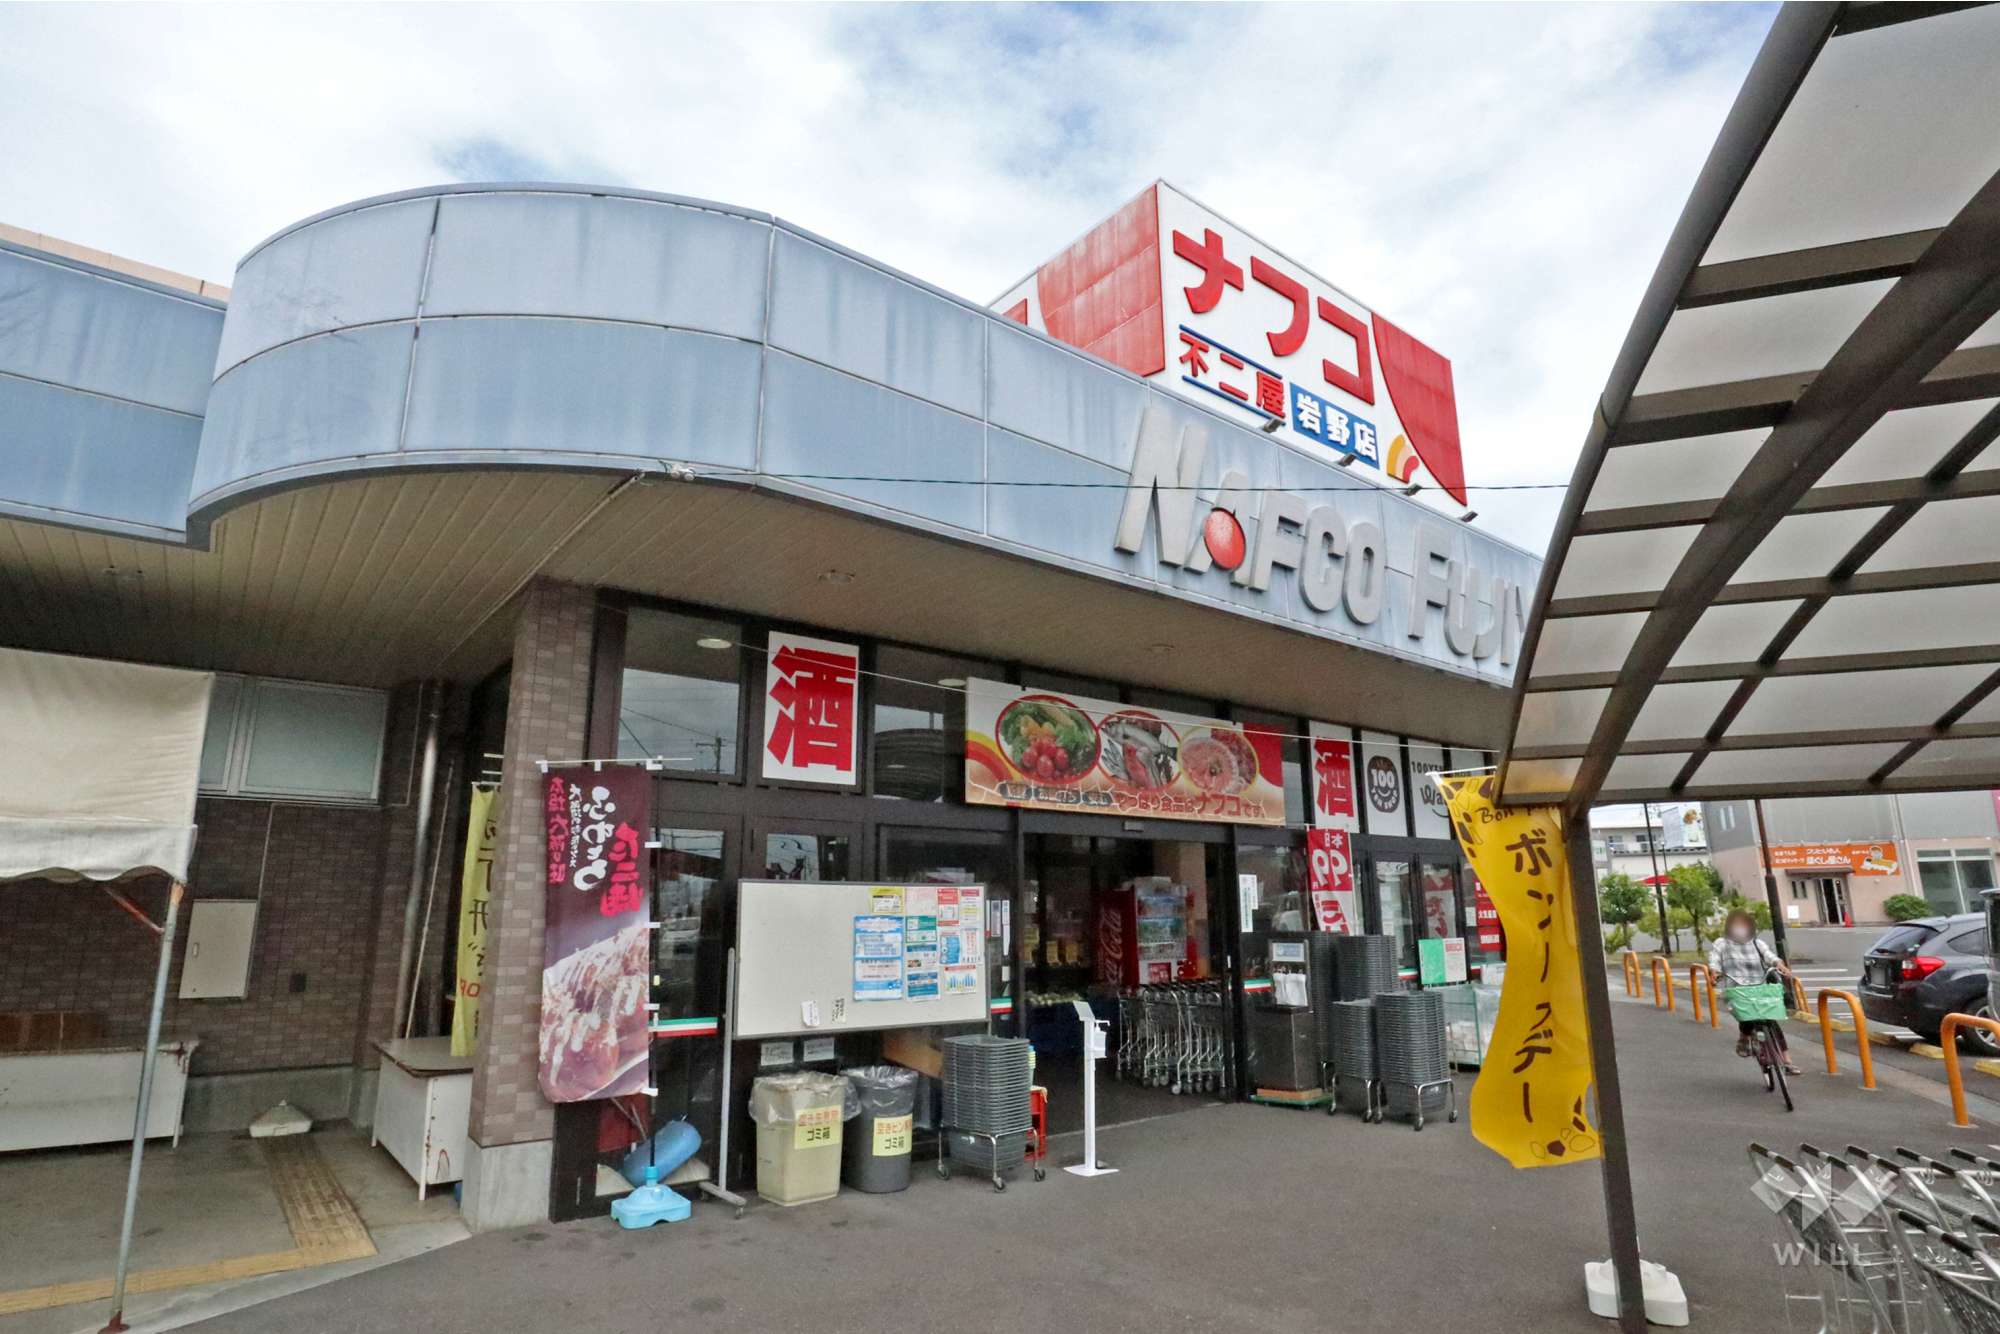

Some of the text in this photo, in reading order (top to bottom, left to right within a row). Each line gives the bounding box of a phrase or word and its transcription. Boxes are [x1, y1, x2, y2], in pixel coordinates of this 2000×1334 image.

[1172, 227, 1375, 406] ナフコ
[1179, 332, 1286, 419] 不二屋
[1296, 393, 1377, 461] 岩野店
[1114, 403, 1525, 666] NAFCO FUJI
[767, 644, 856, 771] 酒
[1314, 737, 1354, 818] 酒
[1371, 769, 1395, 788] 100
